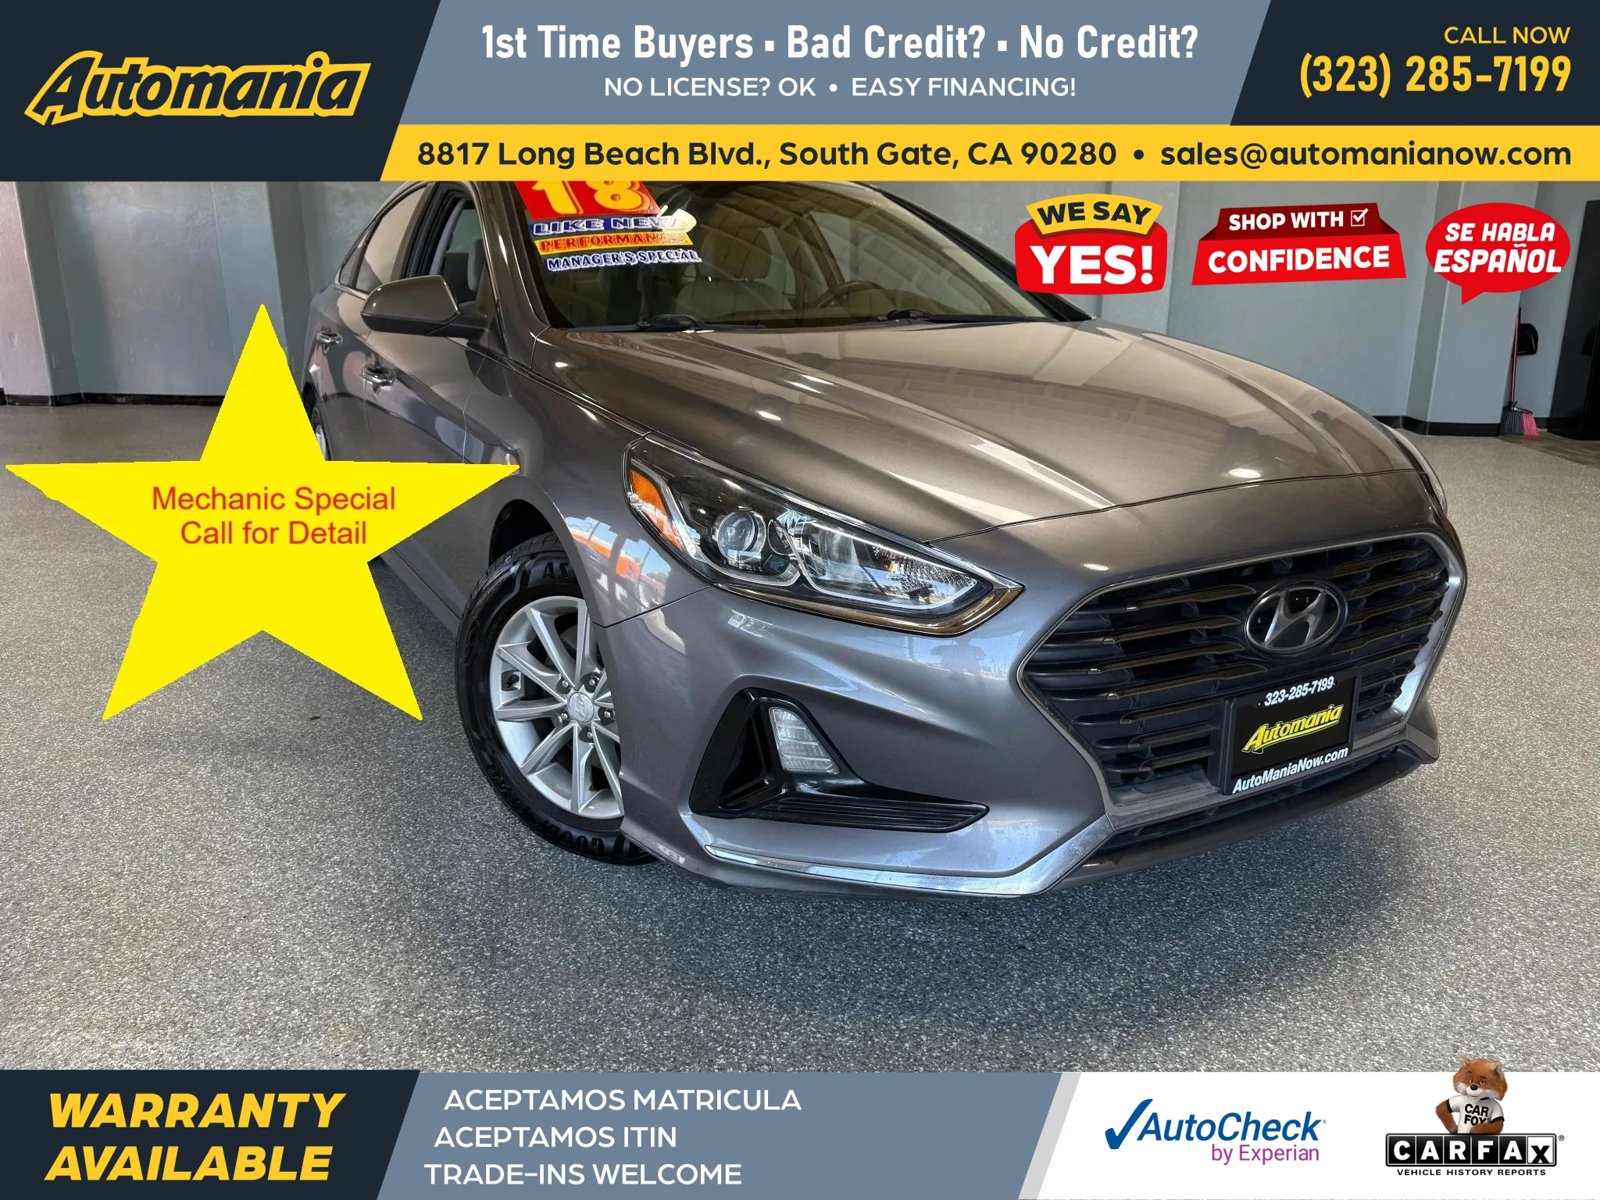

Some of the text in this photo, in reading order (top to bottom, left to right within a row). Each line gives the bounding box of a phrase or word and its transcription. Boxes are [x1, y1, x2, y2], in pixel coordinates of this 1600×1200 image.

[533, 218, 605, 236] LIKE
[541, 232, 690, 253] PERFORMAN
[547, 247, 702, 272] MANAGER'S SPECIAL
[1264, 676, 1335, 707] 323-285-7199
[1241, 704, 1345, 755] Automania
[1232, 747, 1349, 795] AutoManiaNow.com
